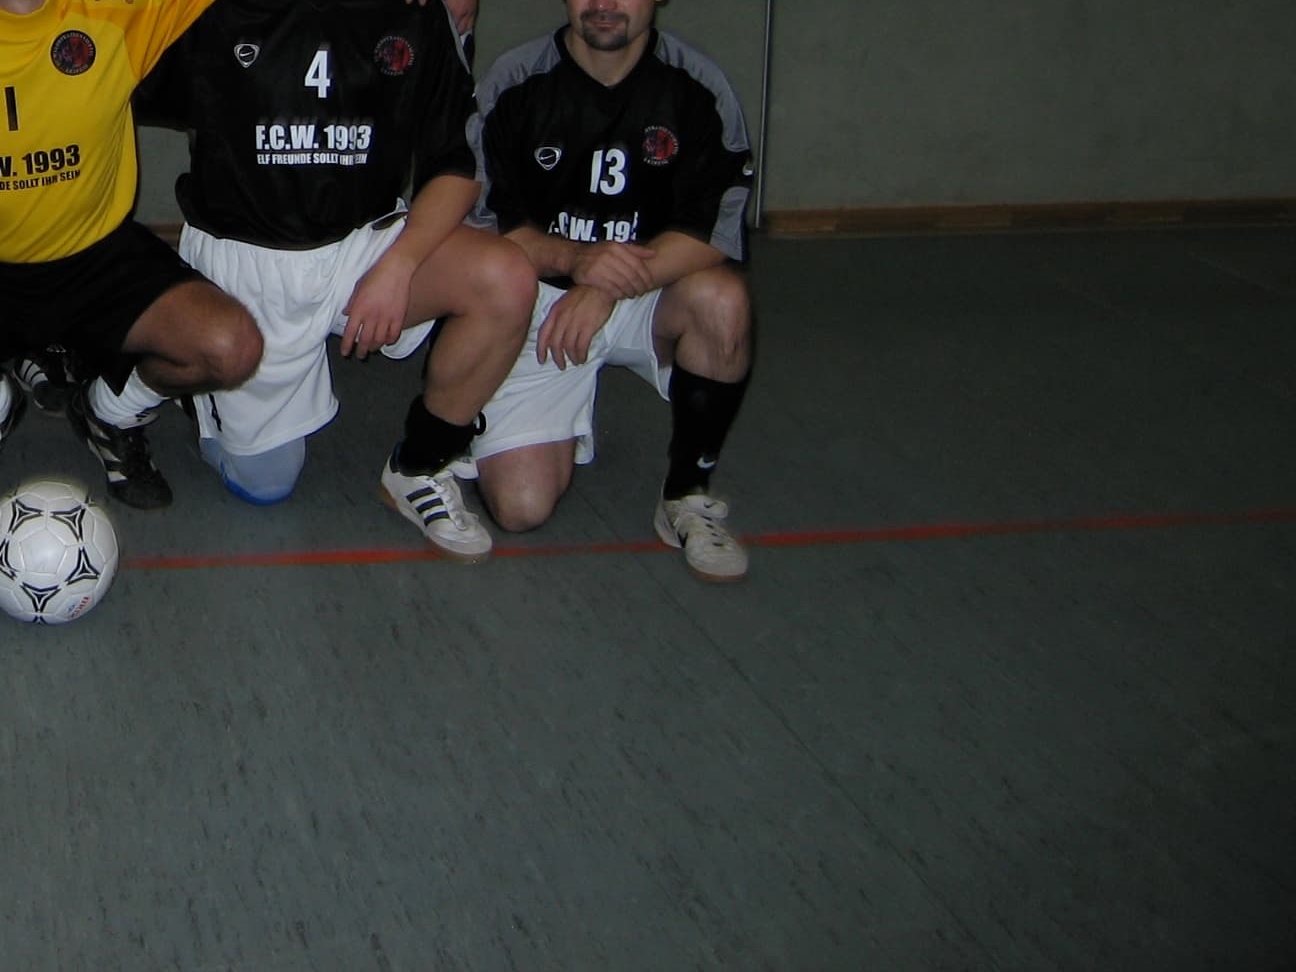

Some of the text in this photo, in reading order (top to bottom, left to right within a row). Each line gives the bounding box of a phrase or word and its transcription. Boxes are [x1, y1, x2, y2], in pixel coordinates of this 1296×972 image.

[304, 50, 331, 98] 4
[5, 87, 18, 131] 1
[256, 124, 372, 151] F.C.W. 1993
[23, 144, 80, 174] 1993
[256, 154, 271, 164] ELF
[272, 153, 312, 164] FREUNDE
[590, 148, 626, 195] 13
[13, 178, 39, 190] SOLLT
[60, 169, 80, 182] SEIN
